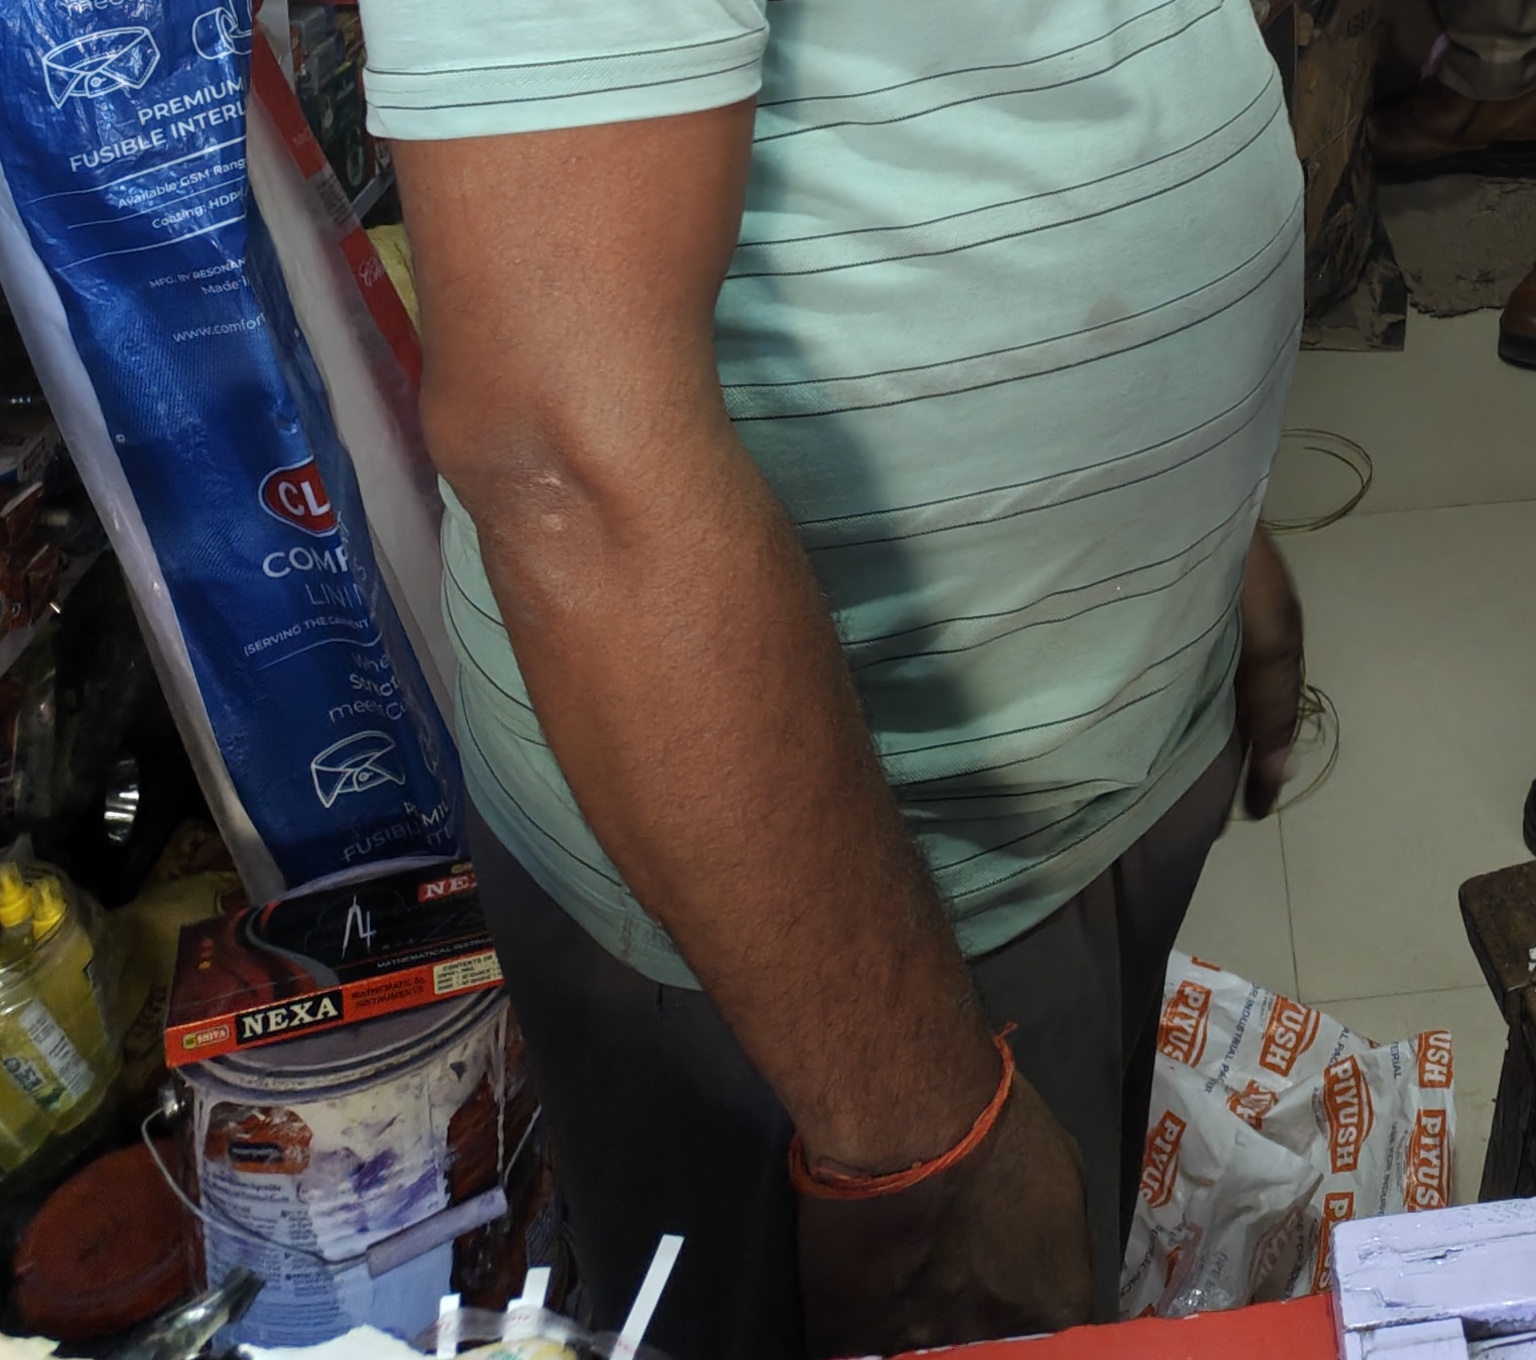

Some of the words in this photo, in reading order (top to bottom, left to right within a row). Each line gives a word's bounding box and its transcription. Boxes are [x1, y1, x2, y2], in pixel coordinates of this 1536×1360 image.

[137, 79, 244, 126] PREMIUM
[69, 127, 166, 173] FUSIBLE
[117, 181, 178, 209] Available
[179, 169, 211, 187] GSM
[201, 281, 239, 296] Made
[241, 998, 339, 1040] NEXA
[1328, 1057, 1359, 1169] PIYUSH
